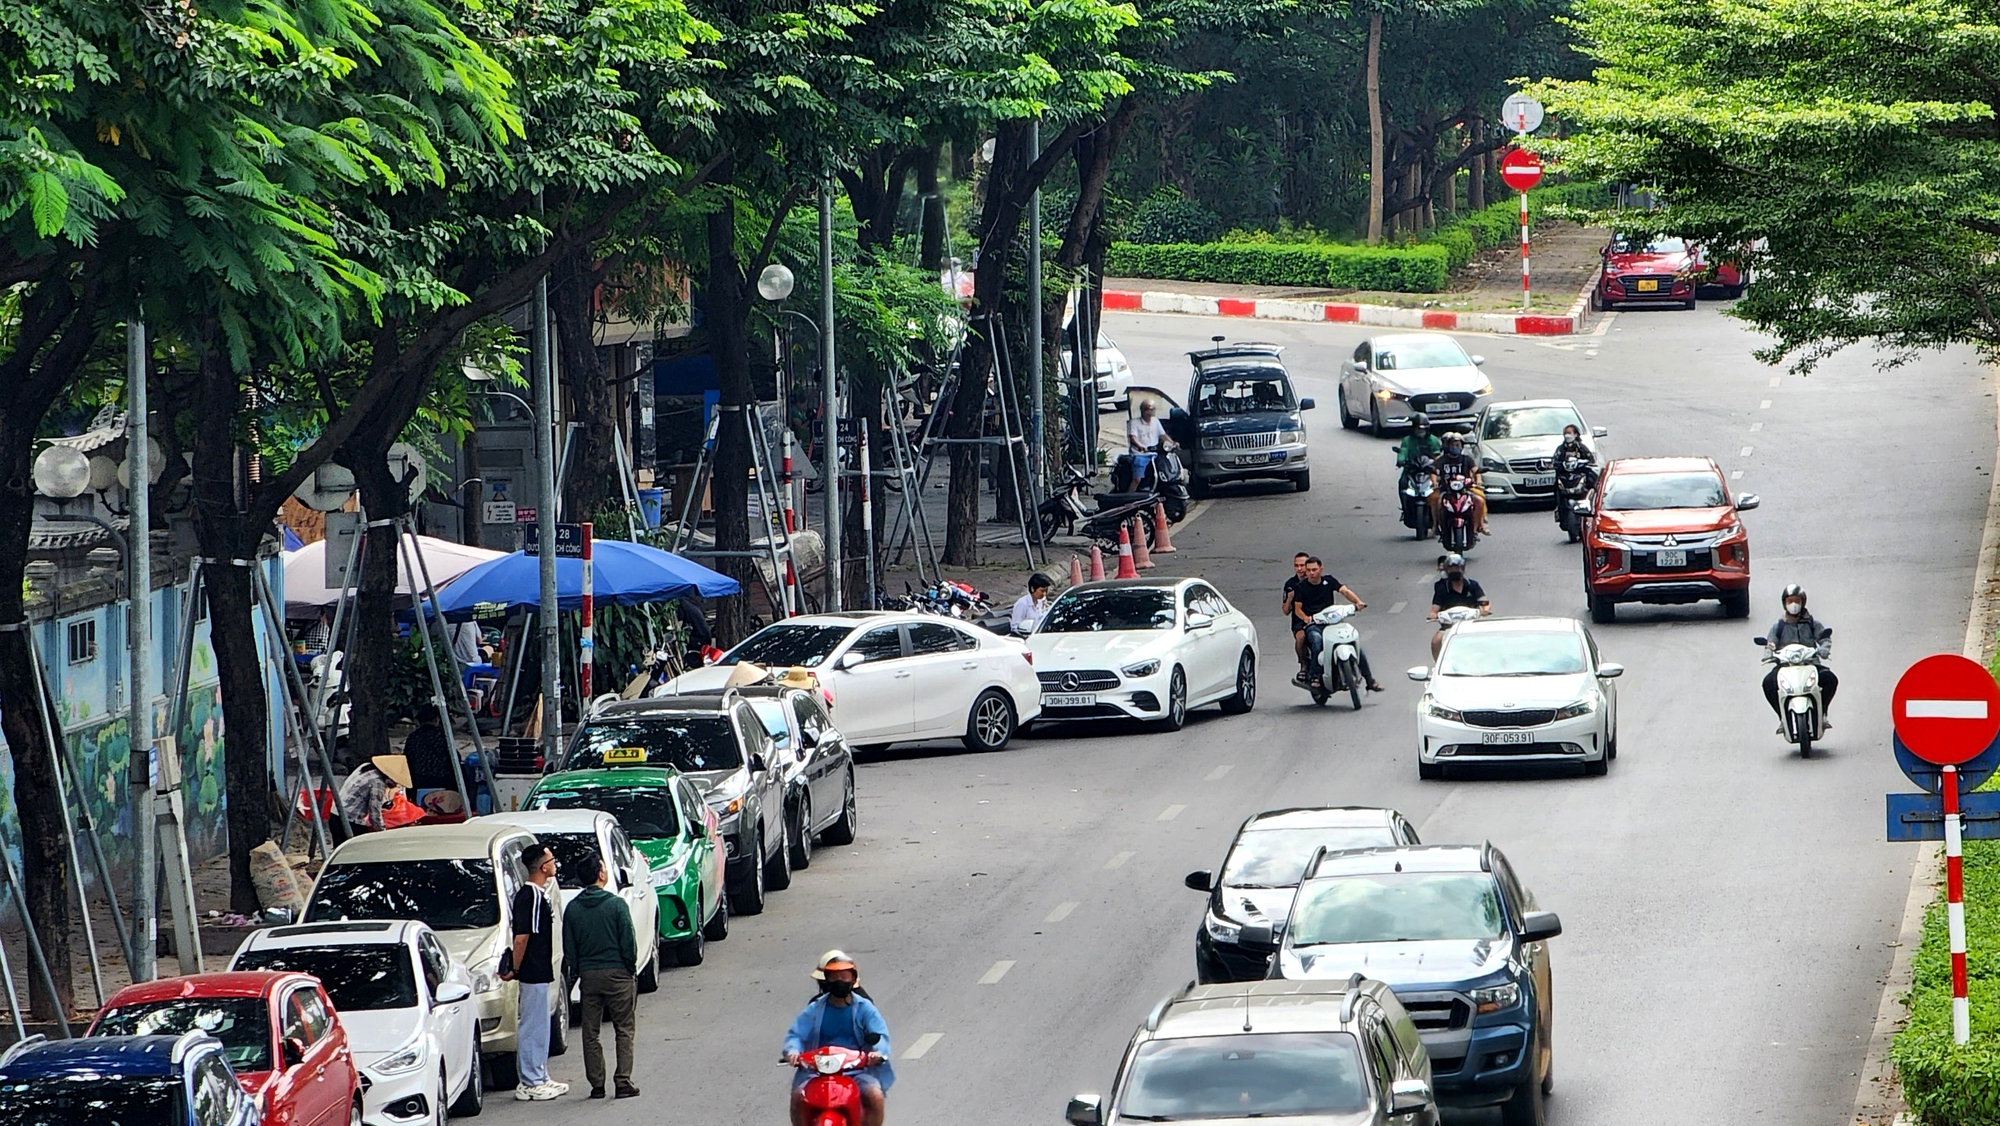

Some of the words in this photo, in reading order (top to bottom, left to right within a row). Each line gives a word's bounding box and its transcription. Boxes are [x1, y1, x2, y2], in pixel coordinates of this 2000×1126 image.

[840, 423, 848, 432] 24
[559, 529, 570, 539] 28
[565, 542, 581, 553] CÔNG
[1665, 551, 1678, 559] 90C
